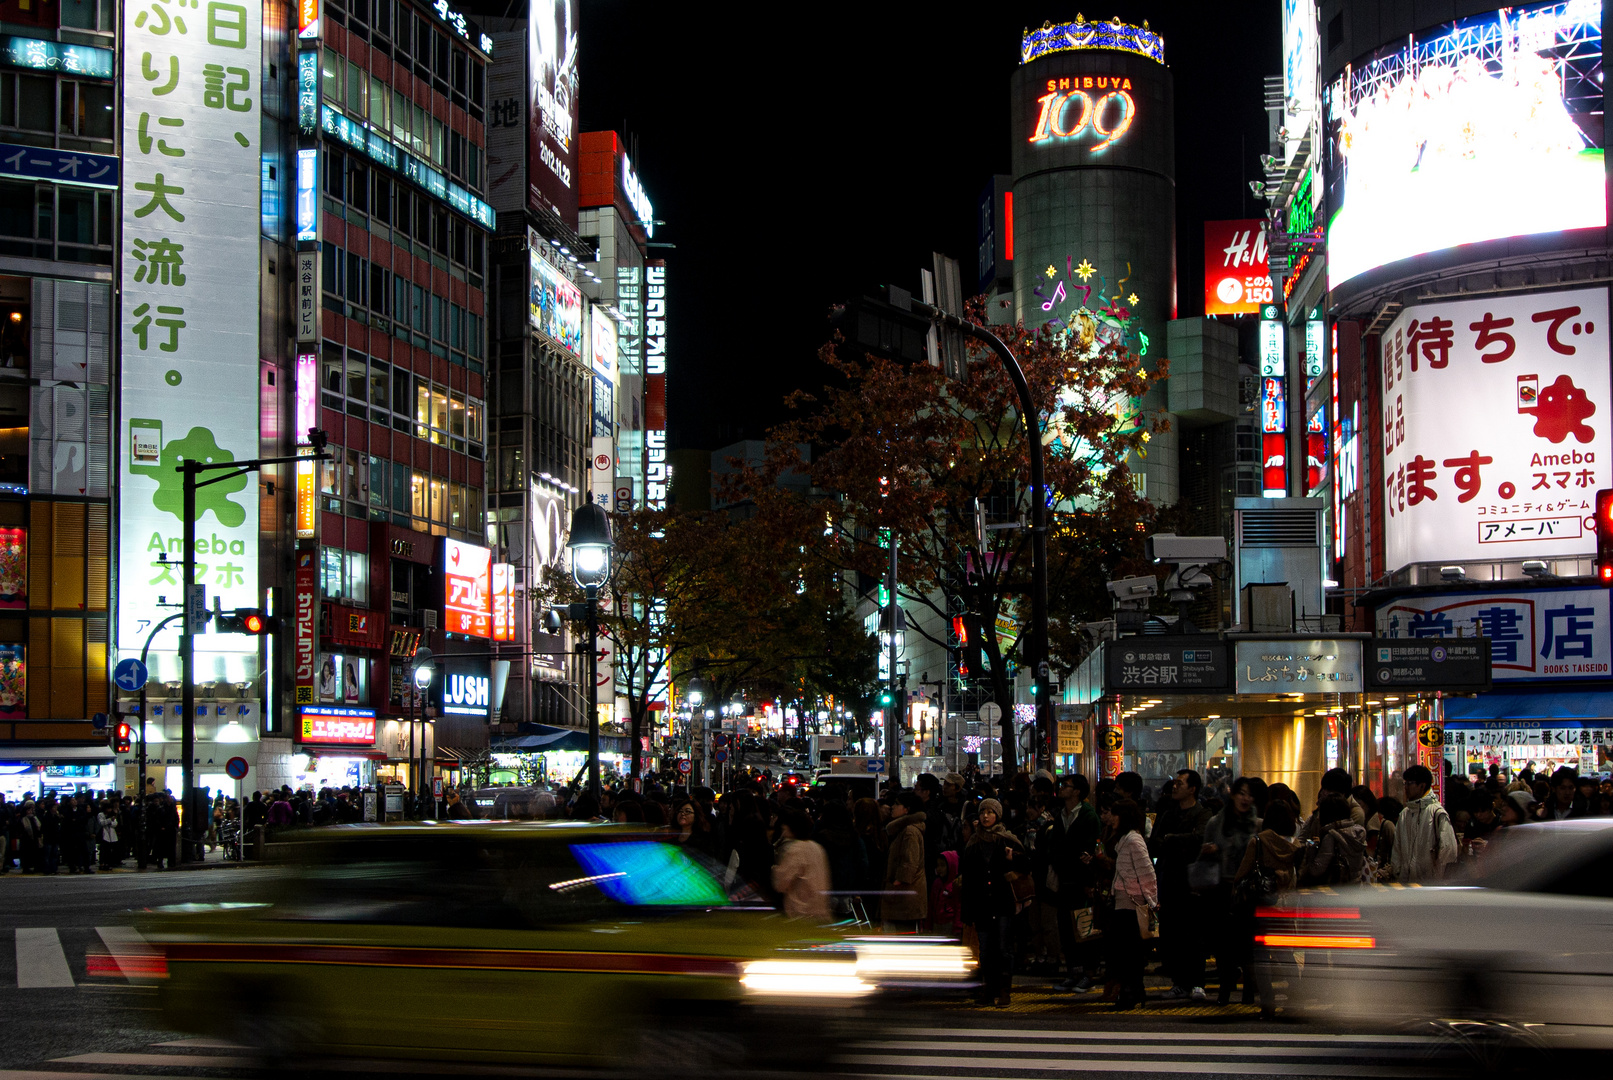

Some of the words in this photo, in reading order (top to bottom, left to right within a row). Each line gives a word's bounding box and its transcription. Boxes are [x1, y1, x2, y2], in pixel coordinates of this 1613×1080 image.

[481, 33, 493, 54] 9F
[203, 1, 252, 148] 日記、
[1047, 77, 1132, 91] SHIBUYA
[1028, 89, 1136, 151] 109
[303, 126, 313, 135] 7F
[5, 150, 110, 178] イーオン
[409, 162, 417, 177] 7F
[540, 140, 571, 189] 2012.11.22
[301, 259, 312, 335] 渋谷駅前ビル
[646, 266, 666, 374] ビックカメラ
[299, 355, 315, 364] 5F
[1265, 378, 1279, 432] カチカチ山
[1384, 394, 1405, 456] 出品
[1530, 449, 1595, 467] Ameba
[1531, 468, 1595, 491] スマホ
[1477, 499, 1590, 516] コミュニティ&ゲーム
[1484, 520, 1560, 541] アメーバ
[461, 614, 472, 631] 3F
[297, 592, 313, 680] サンドラッグ
[1138, 652, 1171, 661] 東急電鉄
[1392, 647, 1430, 656] 田園都市線
[1122, 666, 1178, 684] 渋谷駅
[1182, 665, 1205, 673] Shibuya
[1246, 664, 1314, 682] しぶちか
[1392, 668, 1424, 676] 副都心線
[1543, 664, 1570, 673] BOOKS
[1572, 663, 1608, 673] TAISEIDO
[297, 686, 312, 703] 薬
[444, 674, 488, 706] LUSH
[1104, 731, 1117, 746] 6
[1427, 727, 1438, 742] 6
[124, 758, 161, 766] SHIUYA
